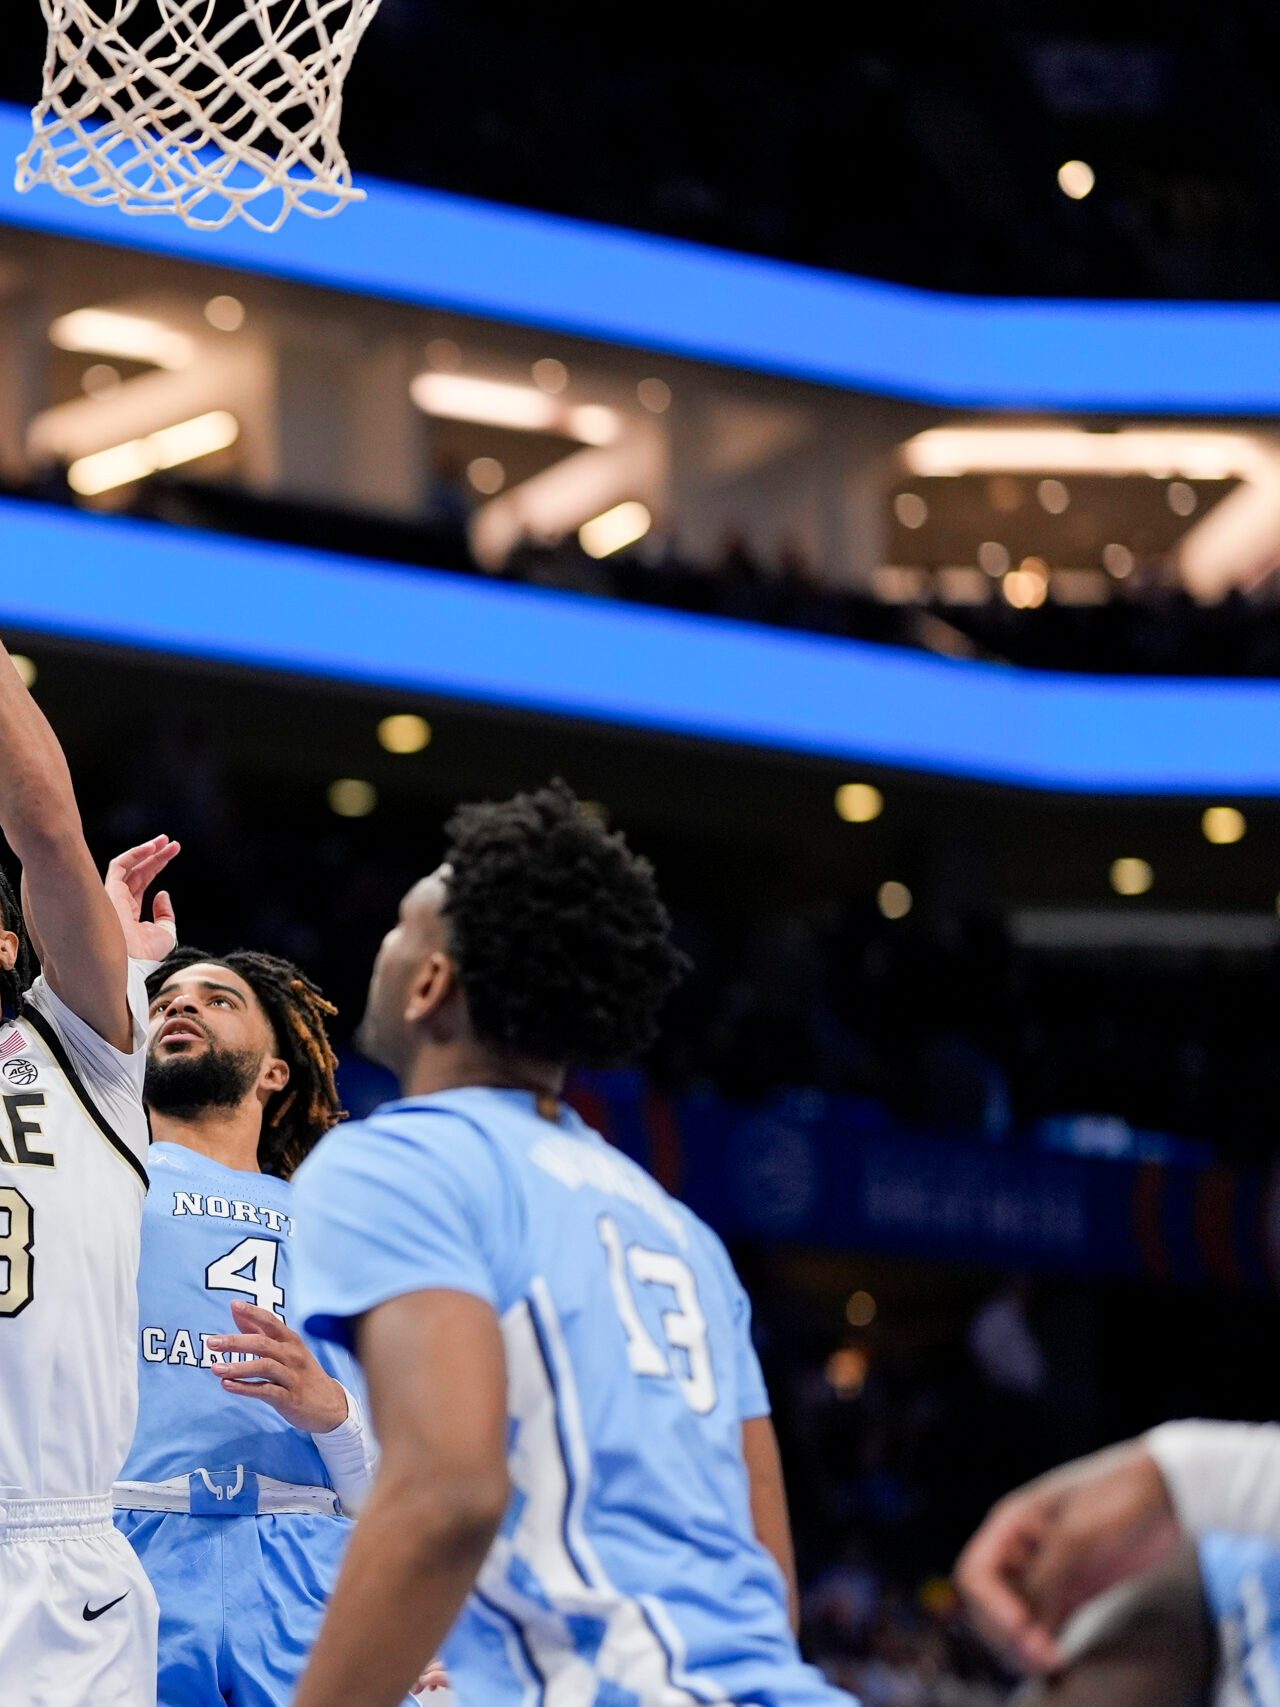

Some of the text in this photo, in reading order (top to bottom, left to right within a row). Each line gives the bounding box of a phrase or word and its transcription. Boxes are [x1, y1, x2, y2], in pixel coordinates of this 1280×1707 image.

[8, 1066, 33, 1077] ACC
[205, 1236, 286, 1326] 4
[596, 1213, 718, 1416] 13
